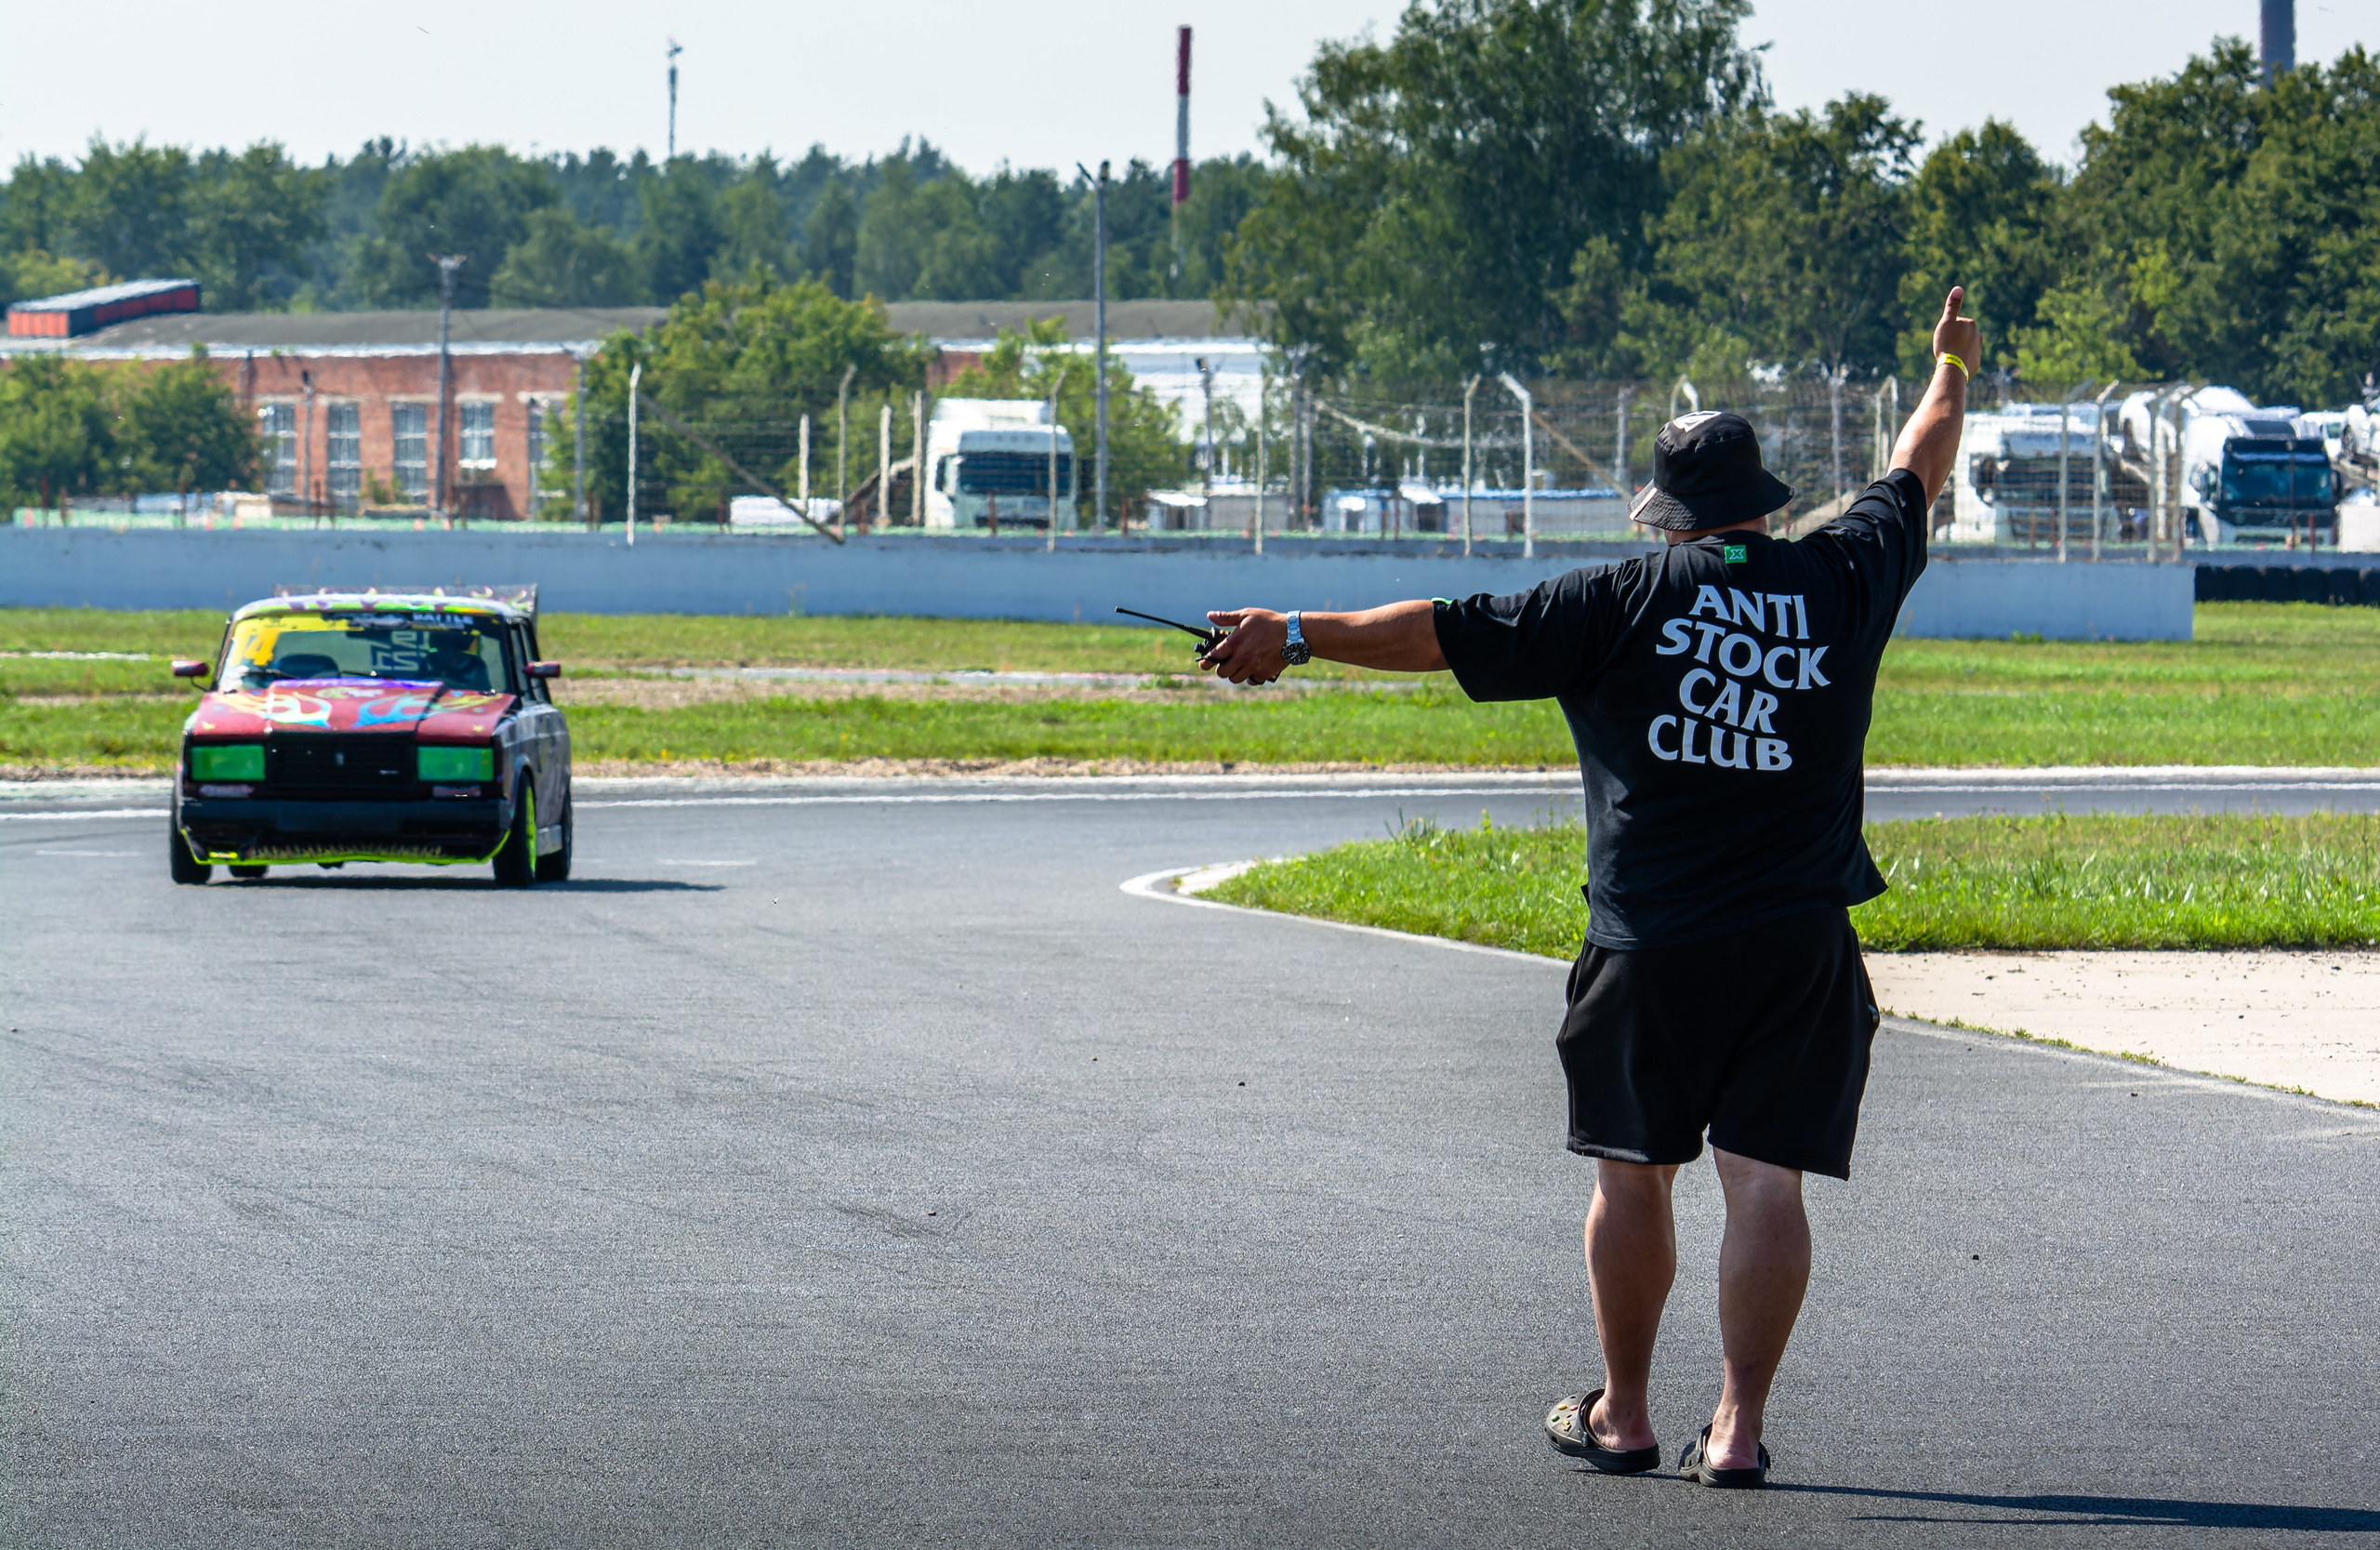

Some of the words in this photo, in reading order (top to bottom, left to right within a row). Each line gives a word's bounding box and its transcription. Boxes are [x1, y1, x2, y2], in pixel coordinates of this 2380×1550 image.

[1688, 585, 1810, 640] ANTI
[1656, 617, 1831, 690] STOCK
[1679, 668, 1778, 734] CAR
[1647, 714, 1792, 771] CLUB
